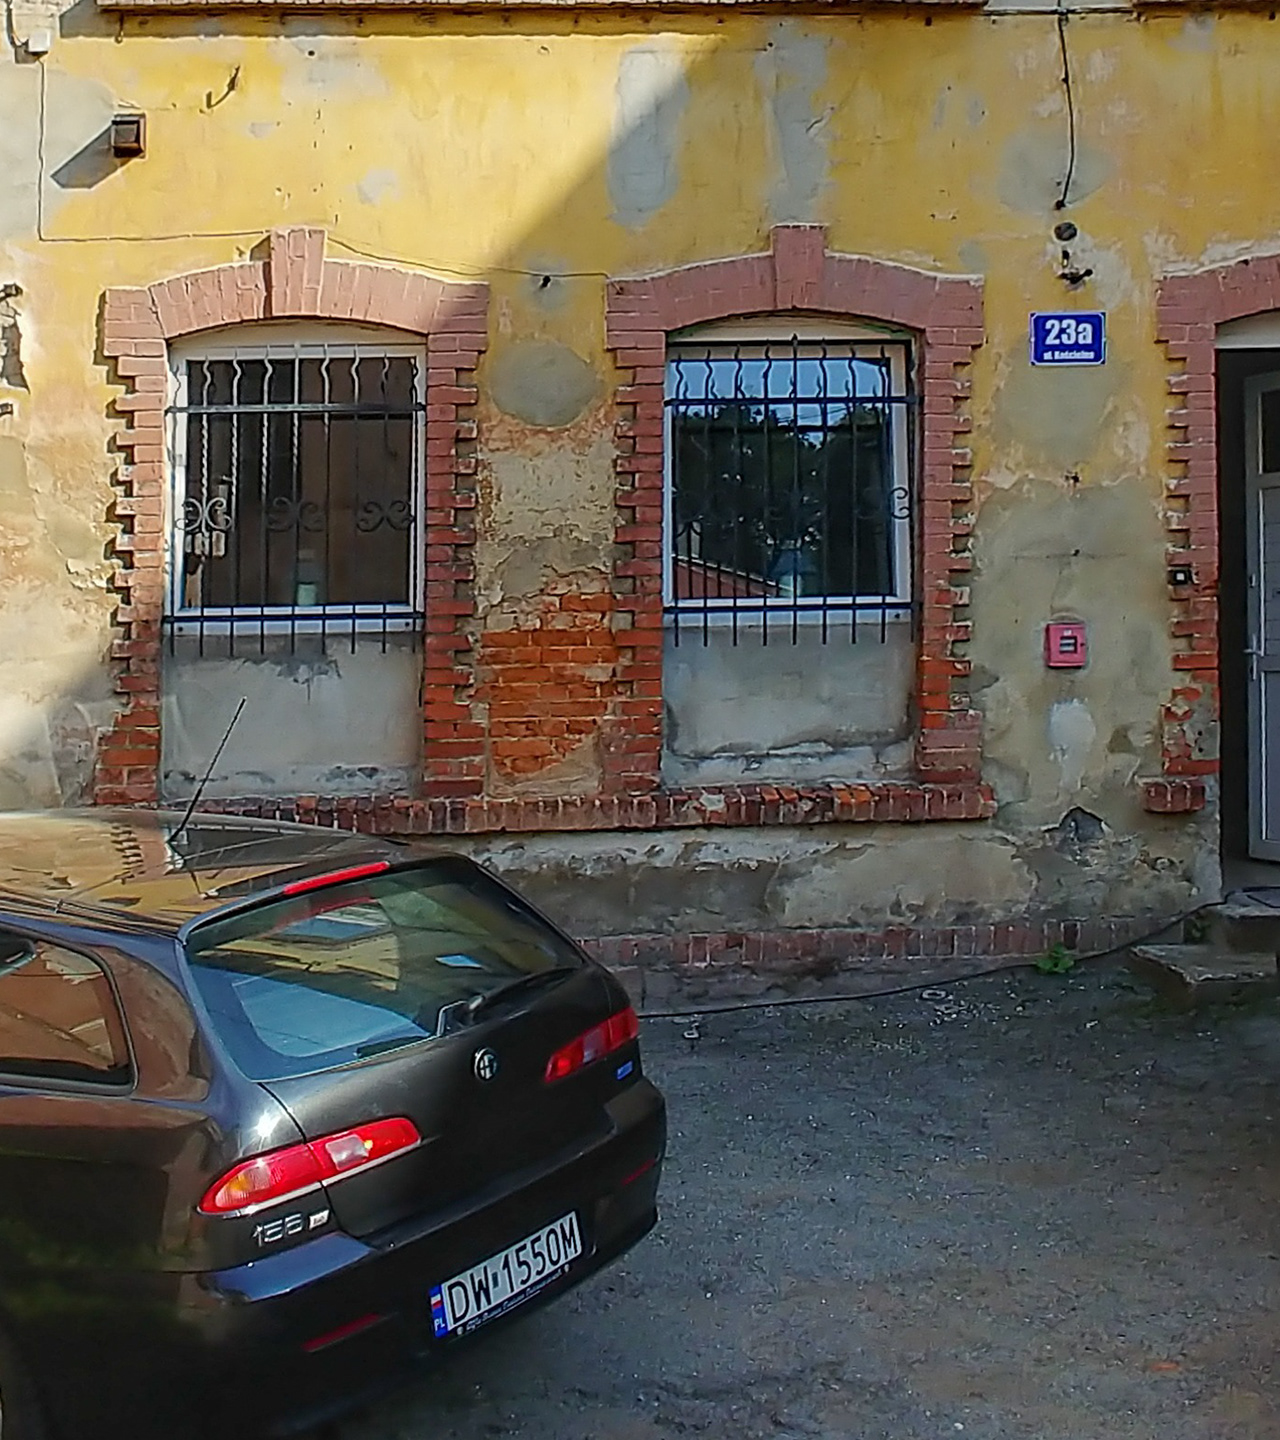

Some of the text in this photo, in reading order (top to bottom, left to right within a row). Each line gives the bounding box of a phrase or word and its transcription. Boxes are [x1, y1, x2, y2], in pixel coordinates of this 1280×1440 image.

[1044, 318, 1093, 345] 23a
[447, 1265, 492, 1325] DW
[500, 1216, 578, 1293] 1550M
[433, 1317, 446, 1332] PL
